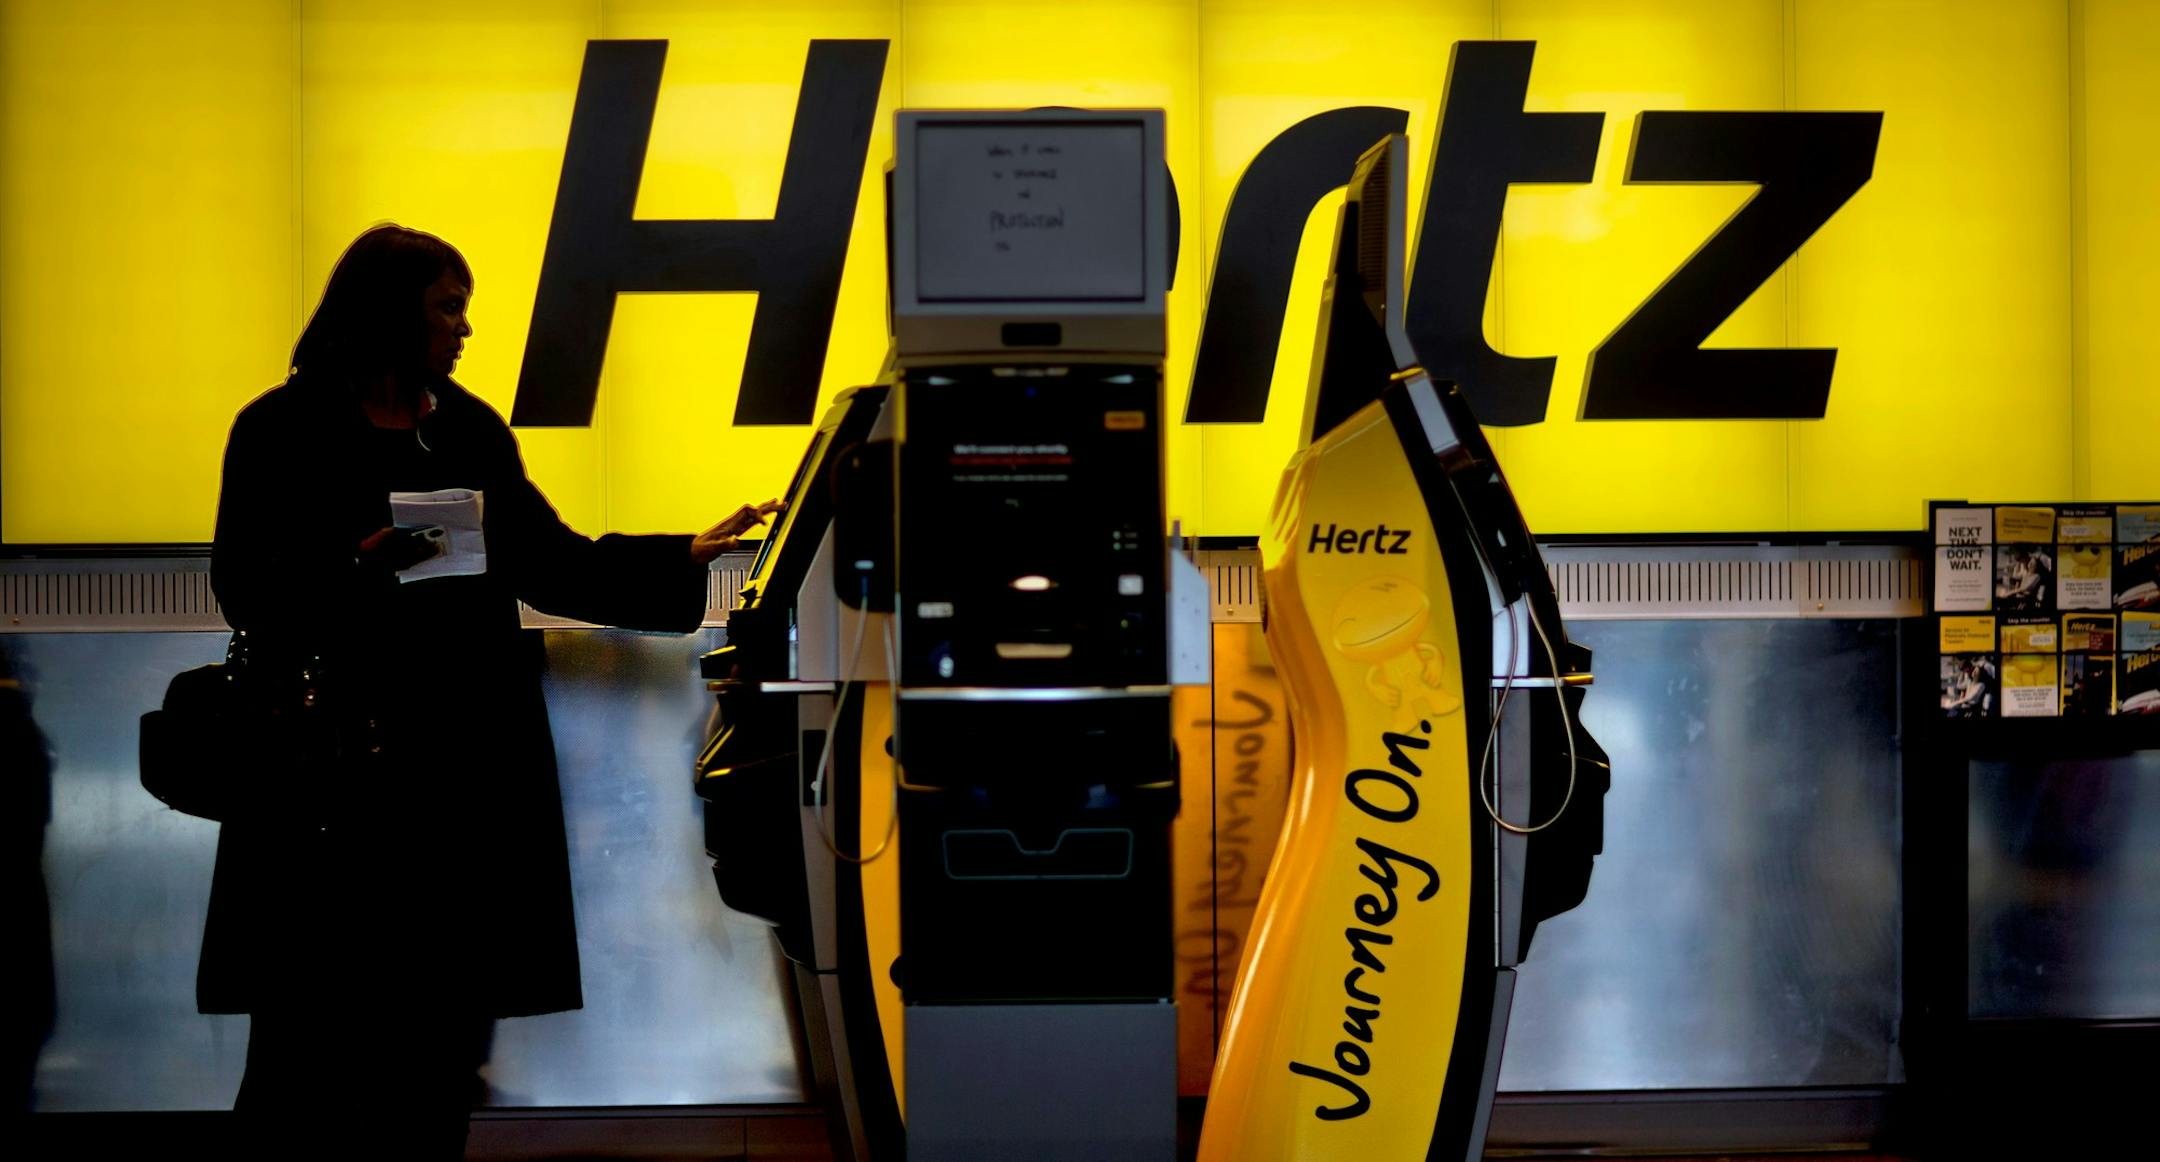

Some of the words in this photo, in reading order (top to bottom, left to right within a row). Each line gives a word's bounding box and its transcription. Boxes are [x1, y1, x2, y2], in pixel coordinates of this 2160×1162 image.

[511, 38, 1884, 427] Hrtz
[1307, 523, 1412, 556] Hertz
[1948, 526, 1983, 538] NEXT
[1946, 548, 1985, 560] DON'T
[1950, 560, 1982, 571] WAIT.
[2007, 617, 2019, 625] Skip
[1345, 719, 1433, 823] On.
[1289, 836, 1441, 1121] Journey
